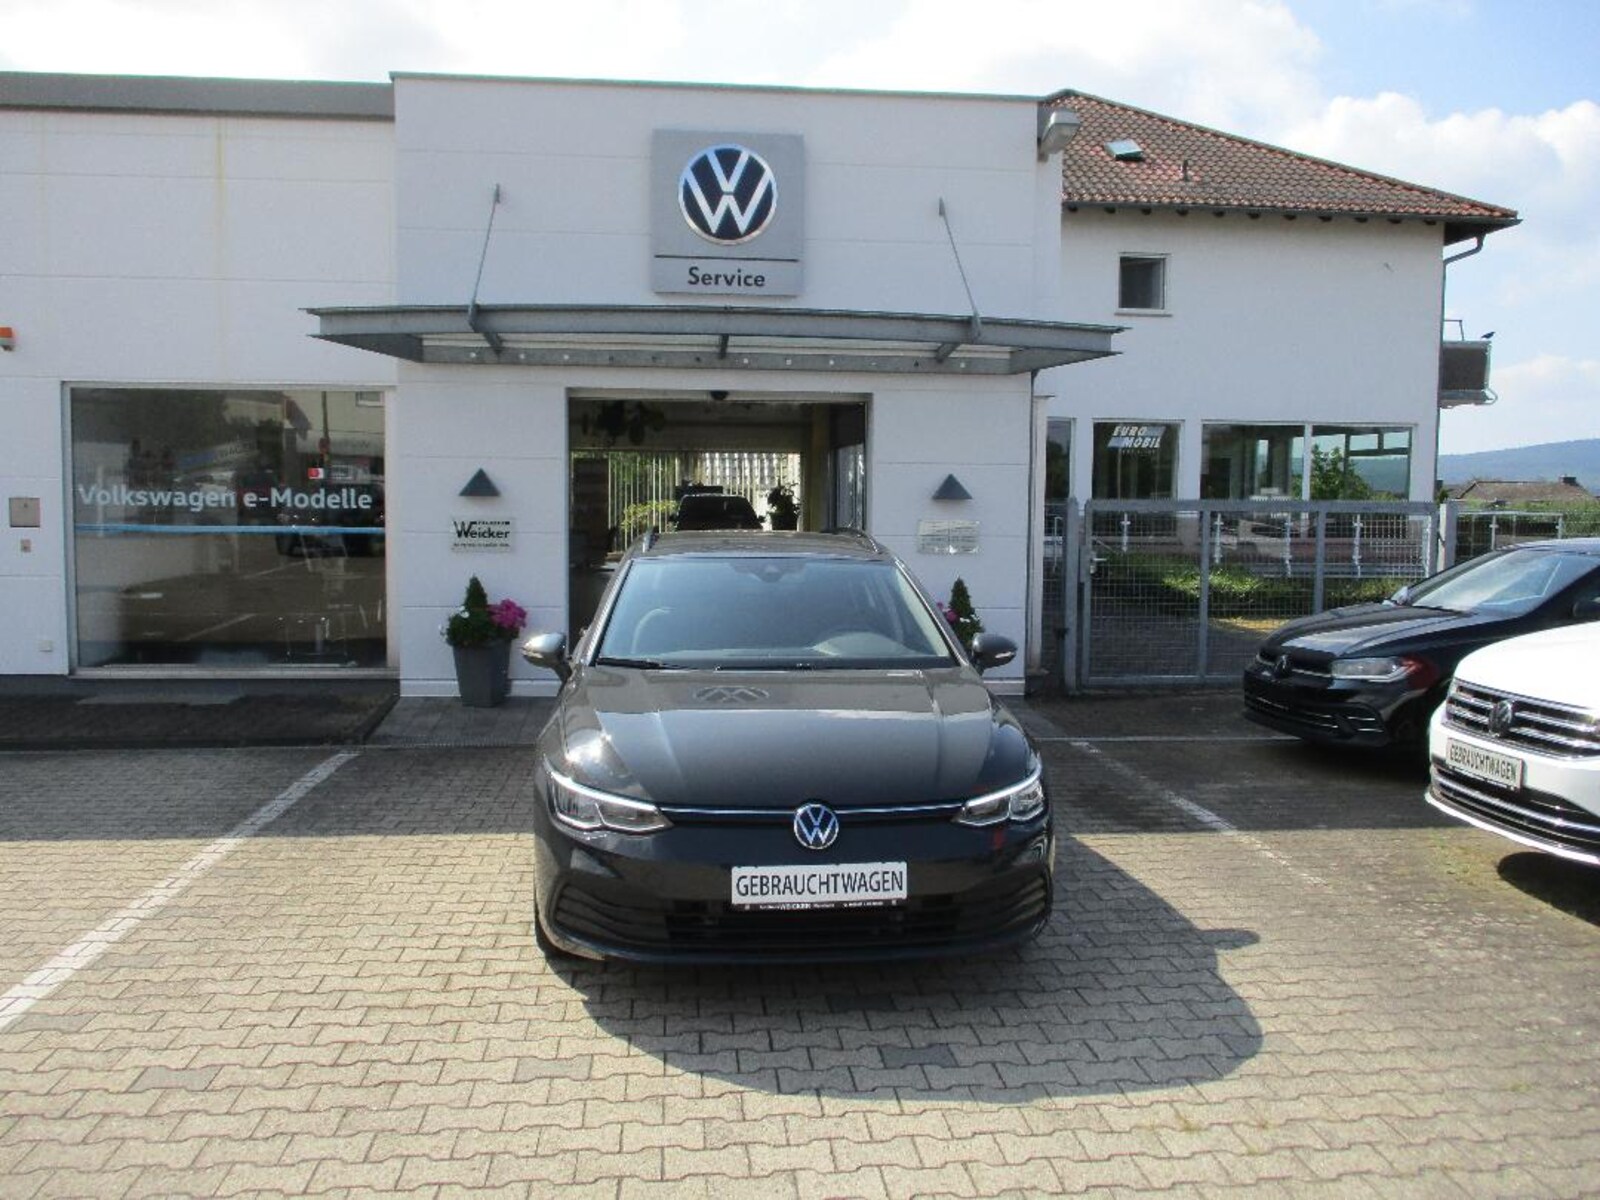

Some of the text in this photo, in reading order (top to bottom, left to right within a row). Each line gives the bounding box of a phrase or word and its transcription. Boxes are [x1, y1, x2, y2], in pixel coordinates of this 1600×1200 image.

[687, 266, 766, 287] Service
[1112, 426, 1148, 437] EURO
[1122, 436, 1162, 448] MOBIL
[79, 483, 373, 512] Volkswagen e-Modelle
[453, 520, 510, 538] Weicker
[1450, 744, 1518, 782] GEBRAUCHTWAGEN
[736, 870, 903, 897] GEBRAUCHTWAGEN
